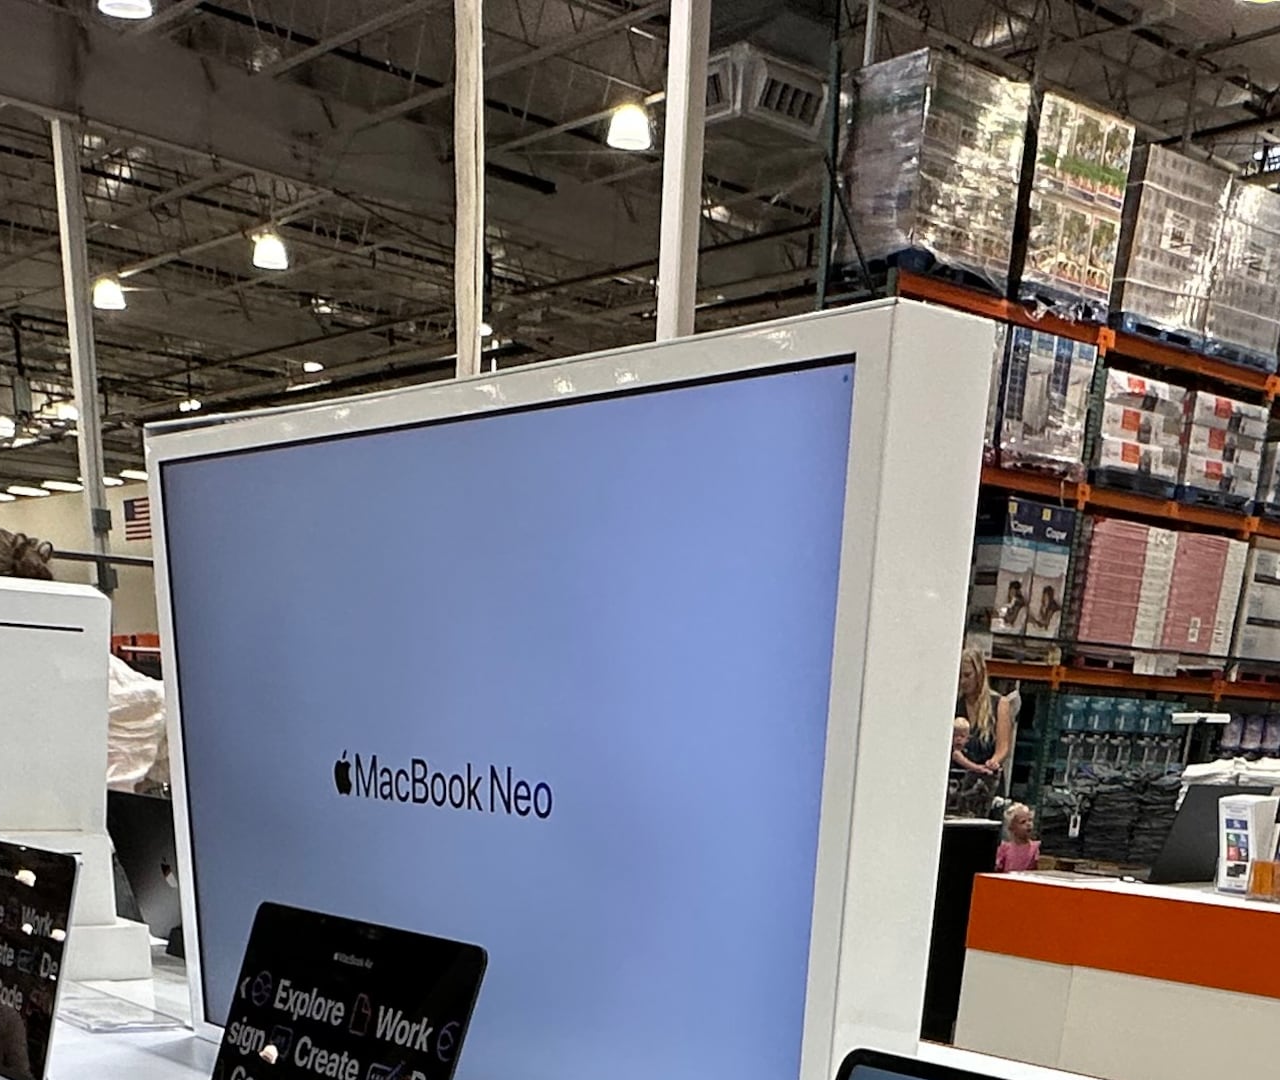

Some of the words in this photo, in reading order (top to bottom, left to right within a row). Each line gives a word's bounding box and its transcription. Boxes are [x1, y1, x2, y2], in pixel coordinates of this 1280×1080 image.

[355, 753, 483, 812] MacBook
[490, 764, 553, 819] Neo
[273, 978, 345, 1026] Explore
[376, 1005, 434, 1052] Work
